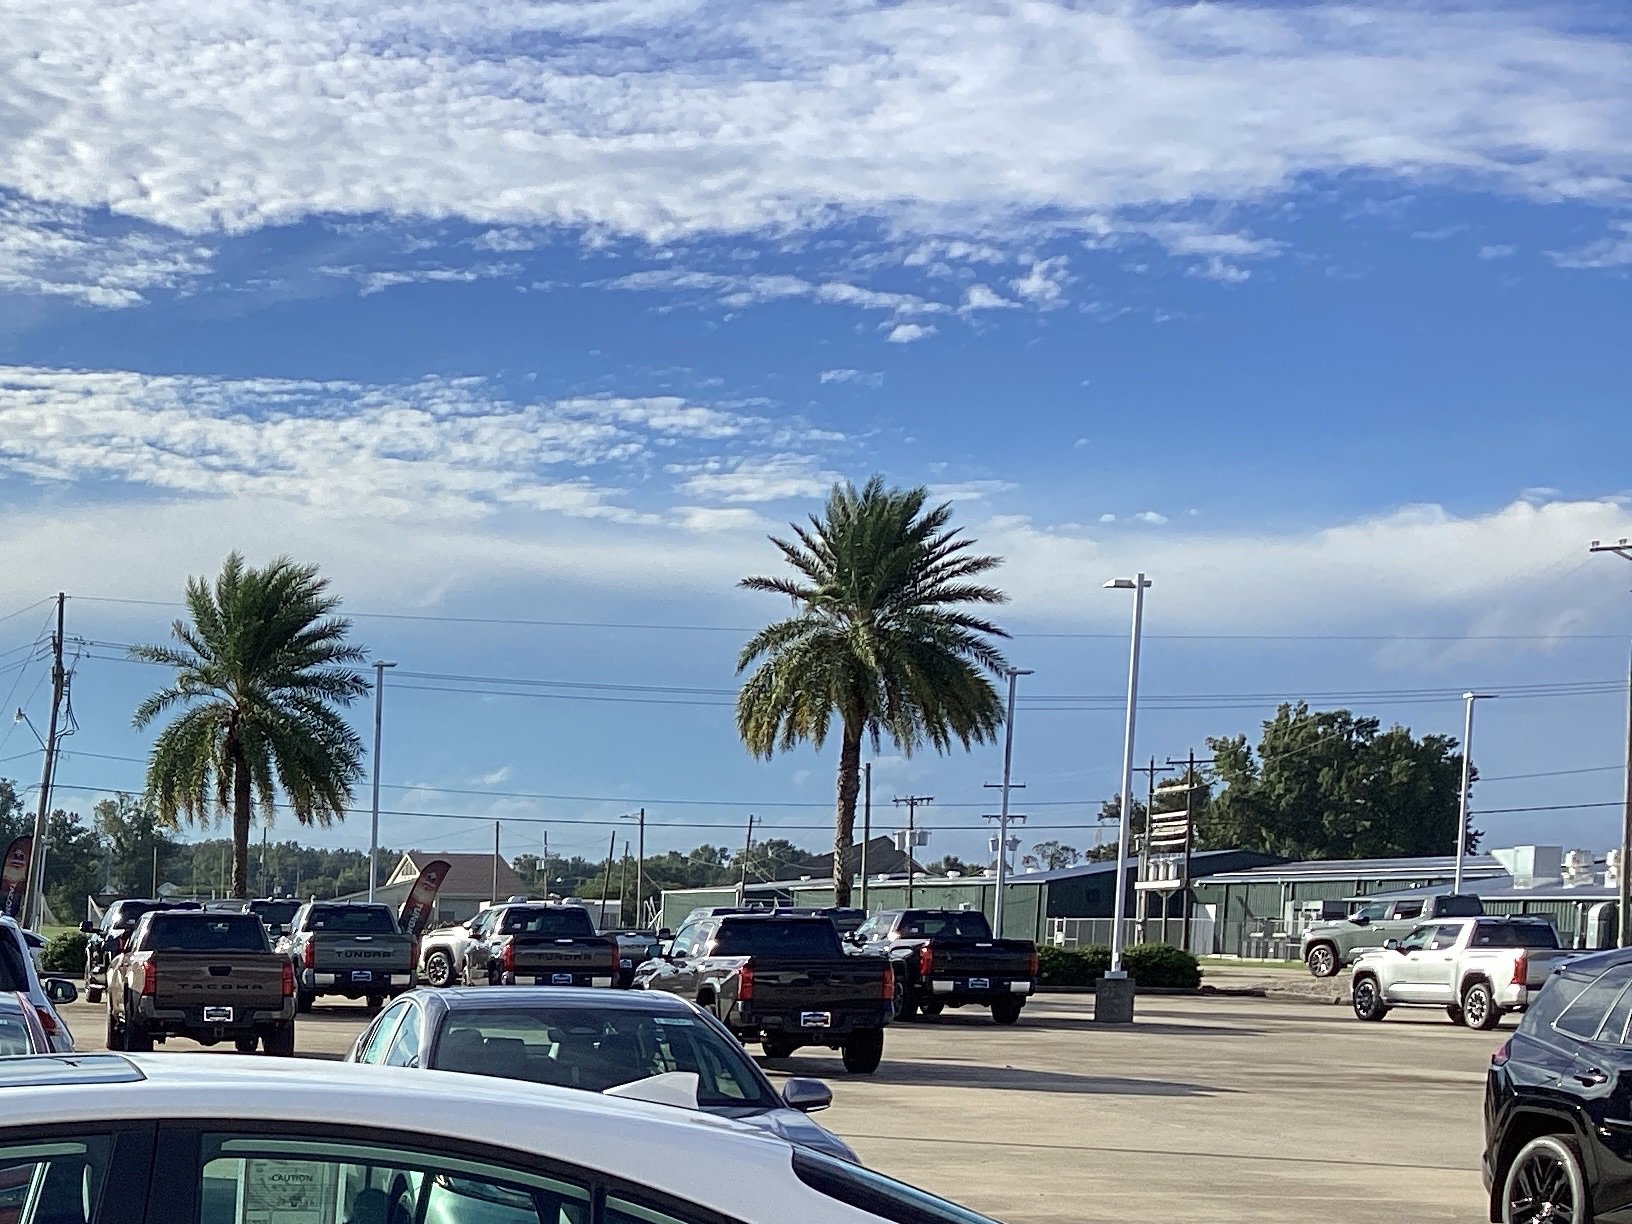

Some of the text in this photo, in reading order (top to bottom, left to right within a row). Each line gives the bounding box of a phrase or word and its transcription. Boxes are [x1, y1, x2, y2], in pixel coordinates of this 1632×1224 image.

[6, 882, 18, 915] TACOM
[407, 903, 424, 935] TUNDR
[336, 950, 391, 958] TUNDRA
[271, 1174, 314, 1182] CAUTION
